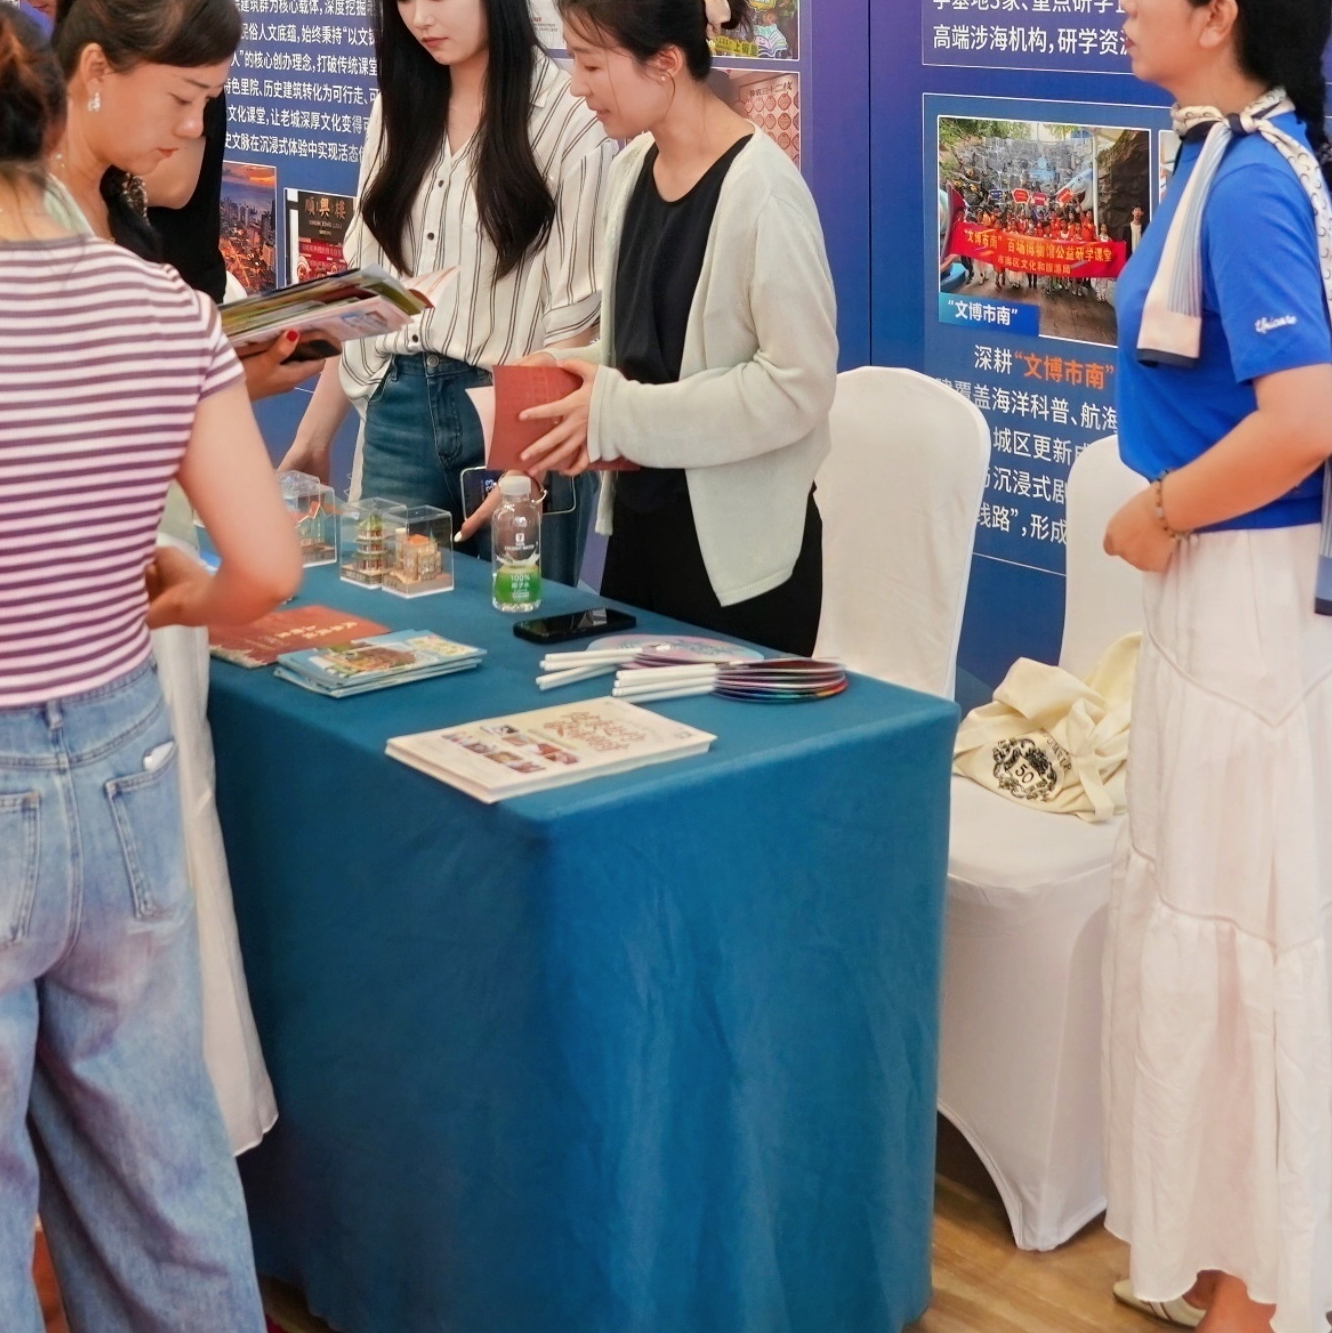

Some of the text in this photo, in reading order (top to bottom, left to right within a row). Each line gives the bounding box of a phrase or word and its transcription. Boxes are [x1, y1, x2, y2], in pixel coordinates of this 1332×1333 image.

[947, 299, 1019, 326] “文博市南”
[974, 344, 1115, 390] 深耕“文博市南”
